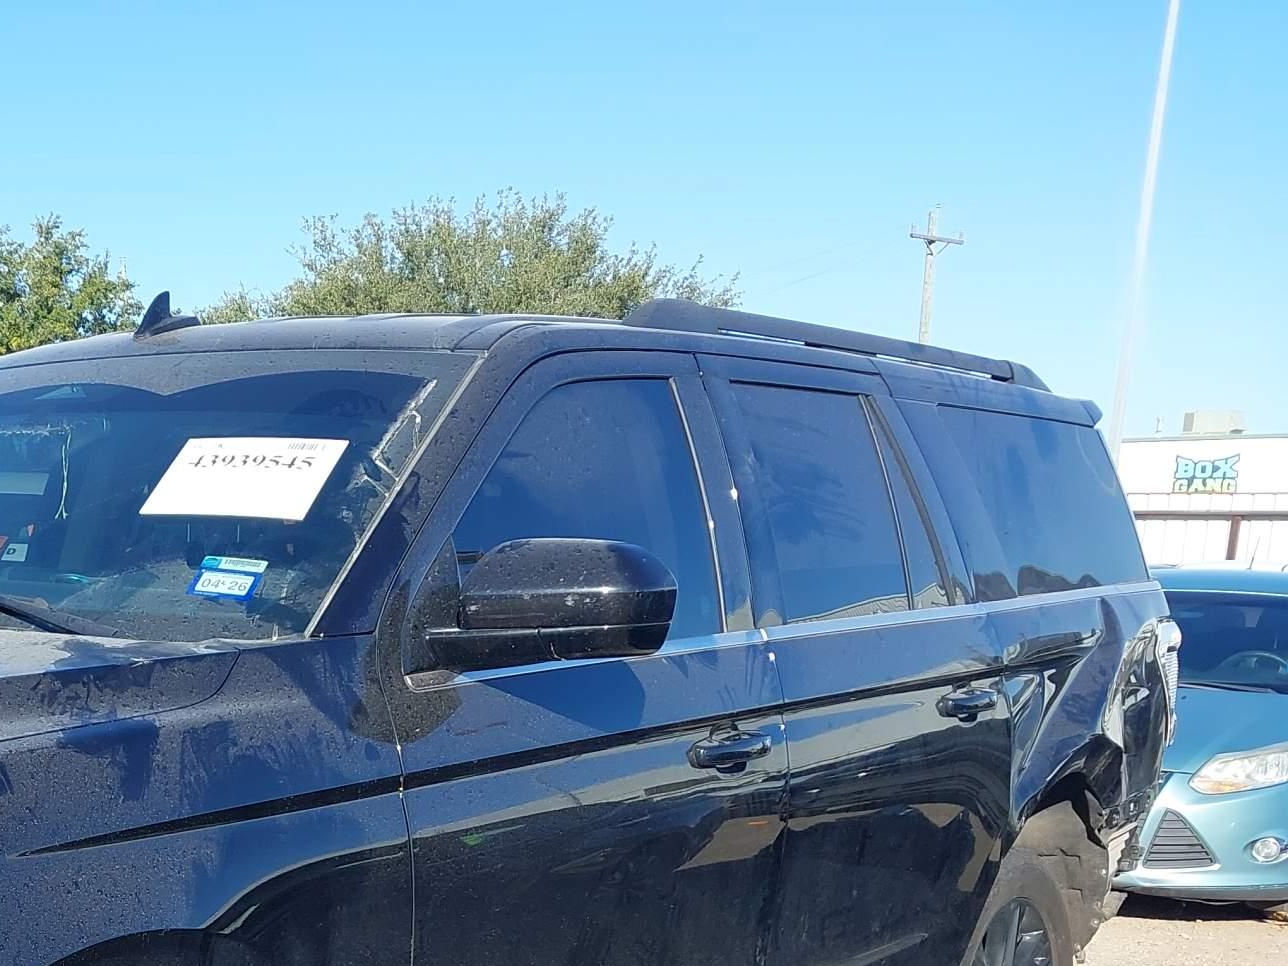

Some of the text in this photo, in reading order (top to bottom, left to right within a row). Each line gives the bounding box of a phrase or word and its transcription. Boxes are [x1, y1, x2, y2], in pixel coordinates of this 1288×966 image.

[188, 454, 317, 471] 43939545
[1174, 454, 1240, 478] BOX
[1172, 478, 1238, 494] GANG
